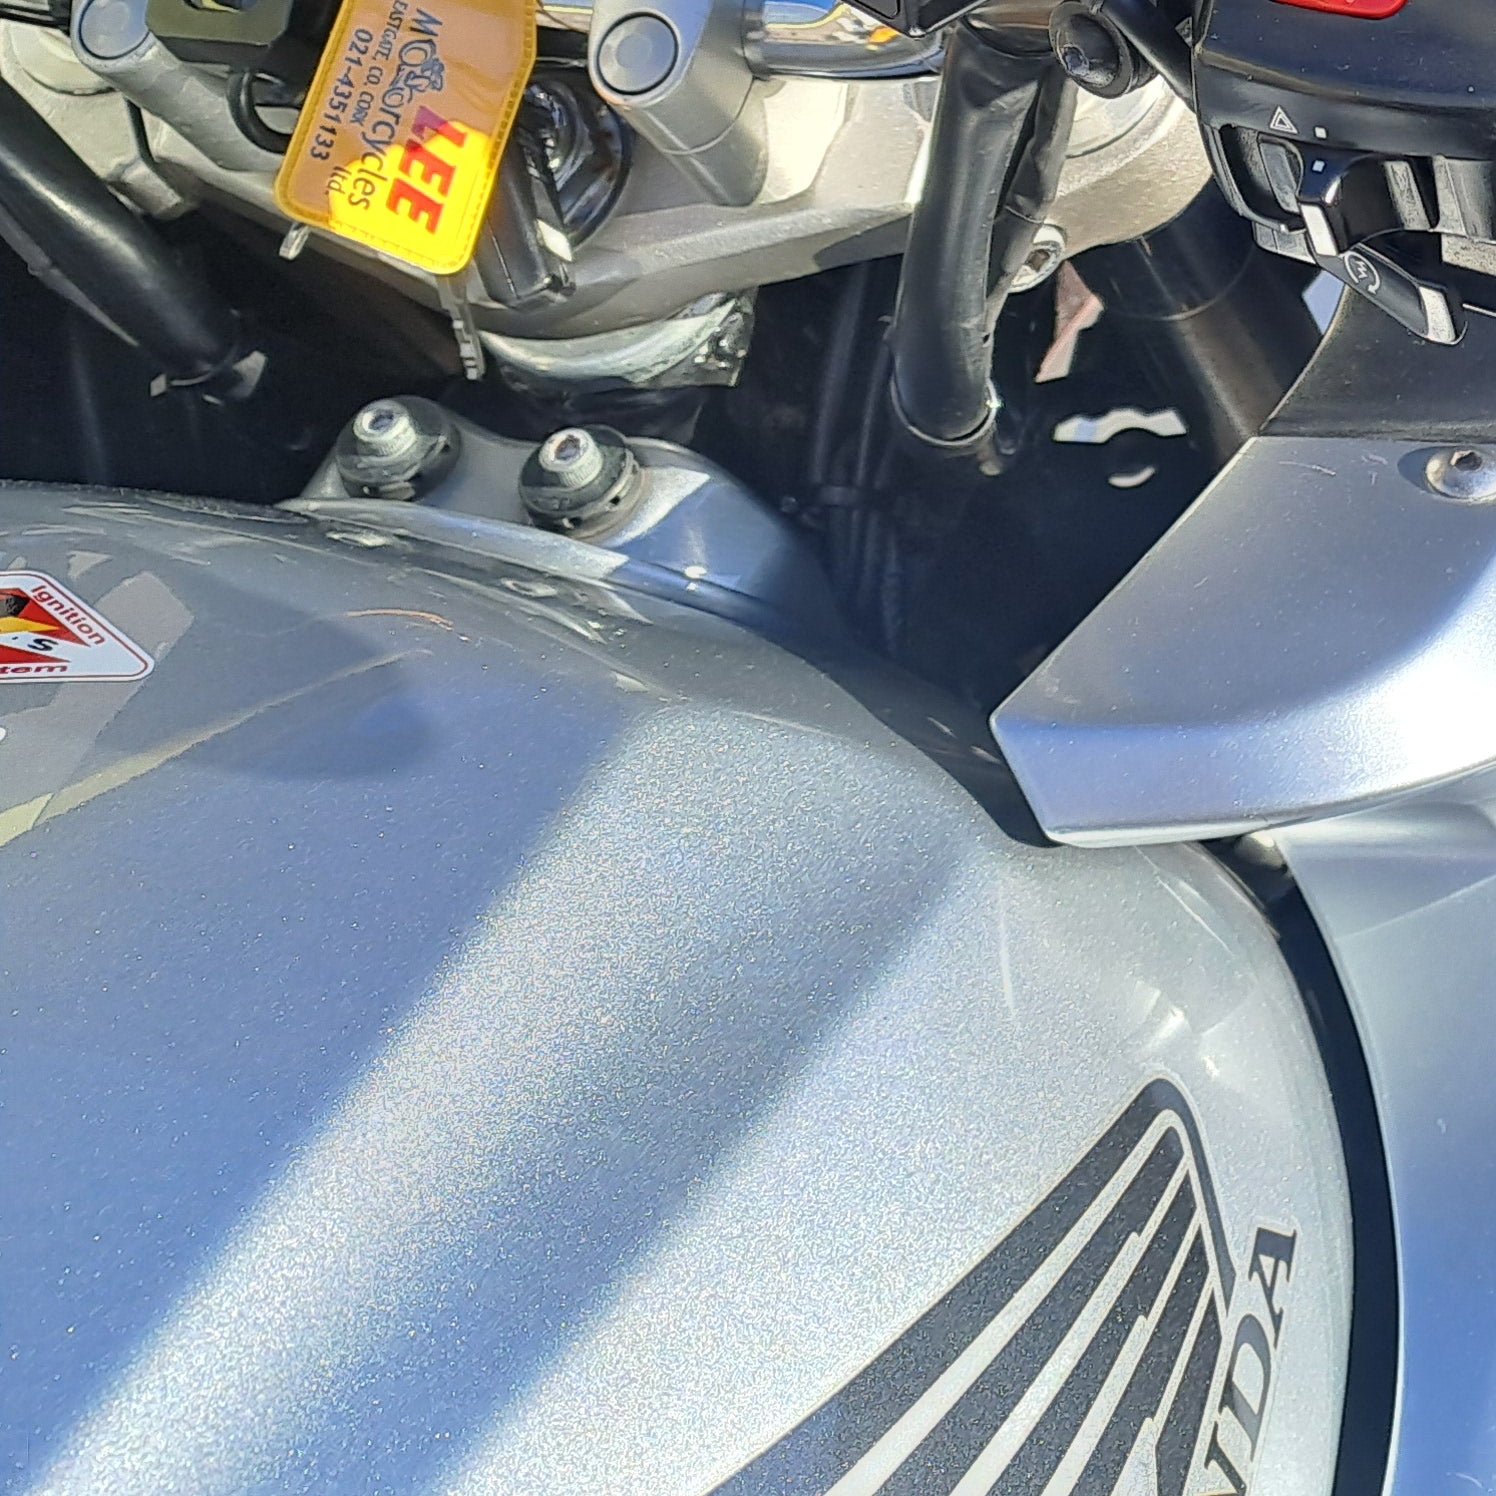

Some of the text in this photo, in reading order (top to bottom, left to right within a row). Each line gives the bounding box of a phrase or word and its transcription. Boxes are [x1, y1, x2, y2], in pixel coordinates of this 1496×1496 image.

[310, 27, 374, 162] 021-4351133
[363, 65, 385, 87] CO.
[350, 90, 375, 128] CORK
[385, 104, 468, 235] LEE
[30, 584, 106, 646] Ignition
